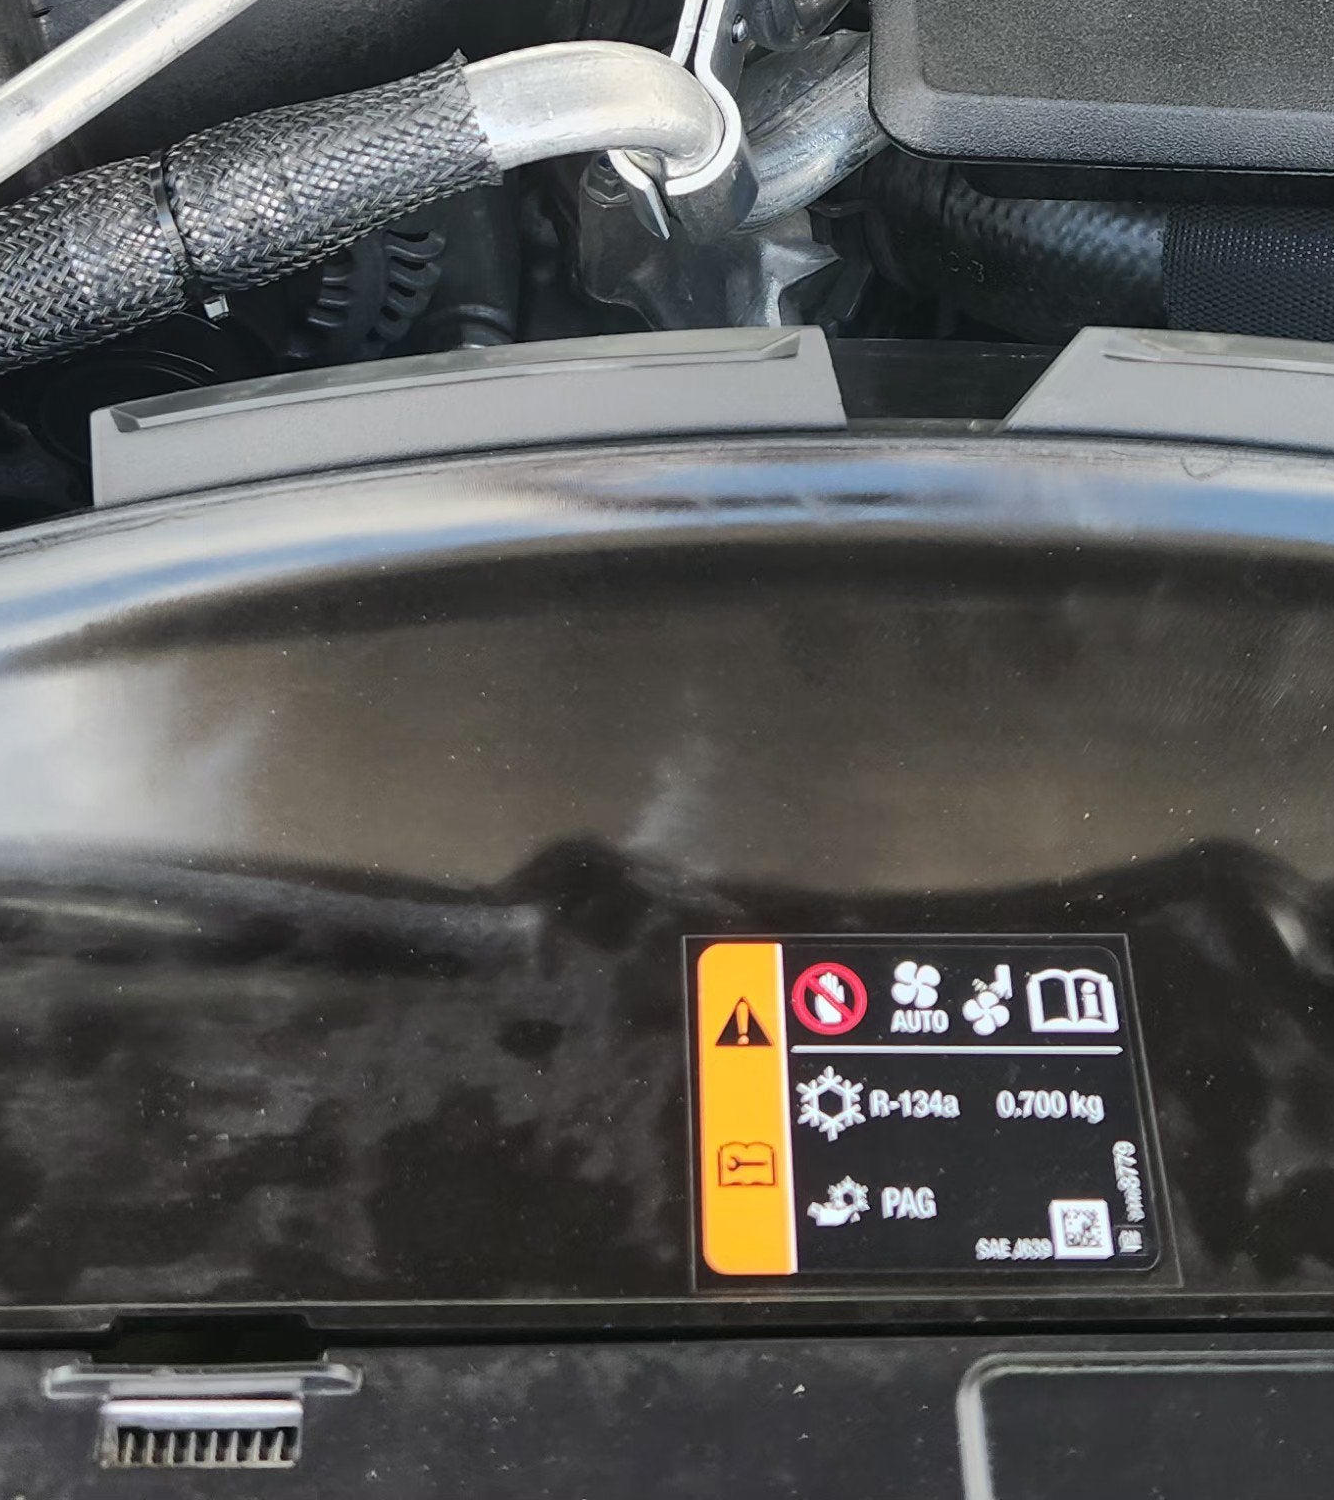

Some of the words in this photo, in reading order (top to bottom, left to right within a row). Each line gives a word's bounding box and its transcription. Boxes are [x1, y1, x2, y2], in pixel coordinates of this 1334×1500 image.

[891, 1009, 949, 1033] AUTO
[869, 1089, 960, 1118] R-134a
[996, 1089, 1067, 1119] 0.700
[1069, 1089, 1105, 1124] kg
[881, 1186, 937, 1219] PAG
[975, 1237, 1011, 1260] SAE
